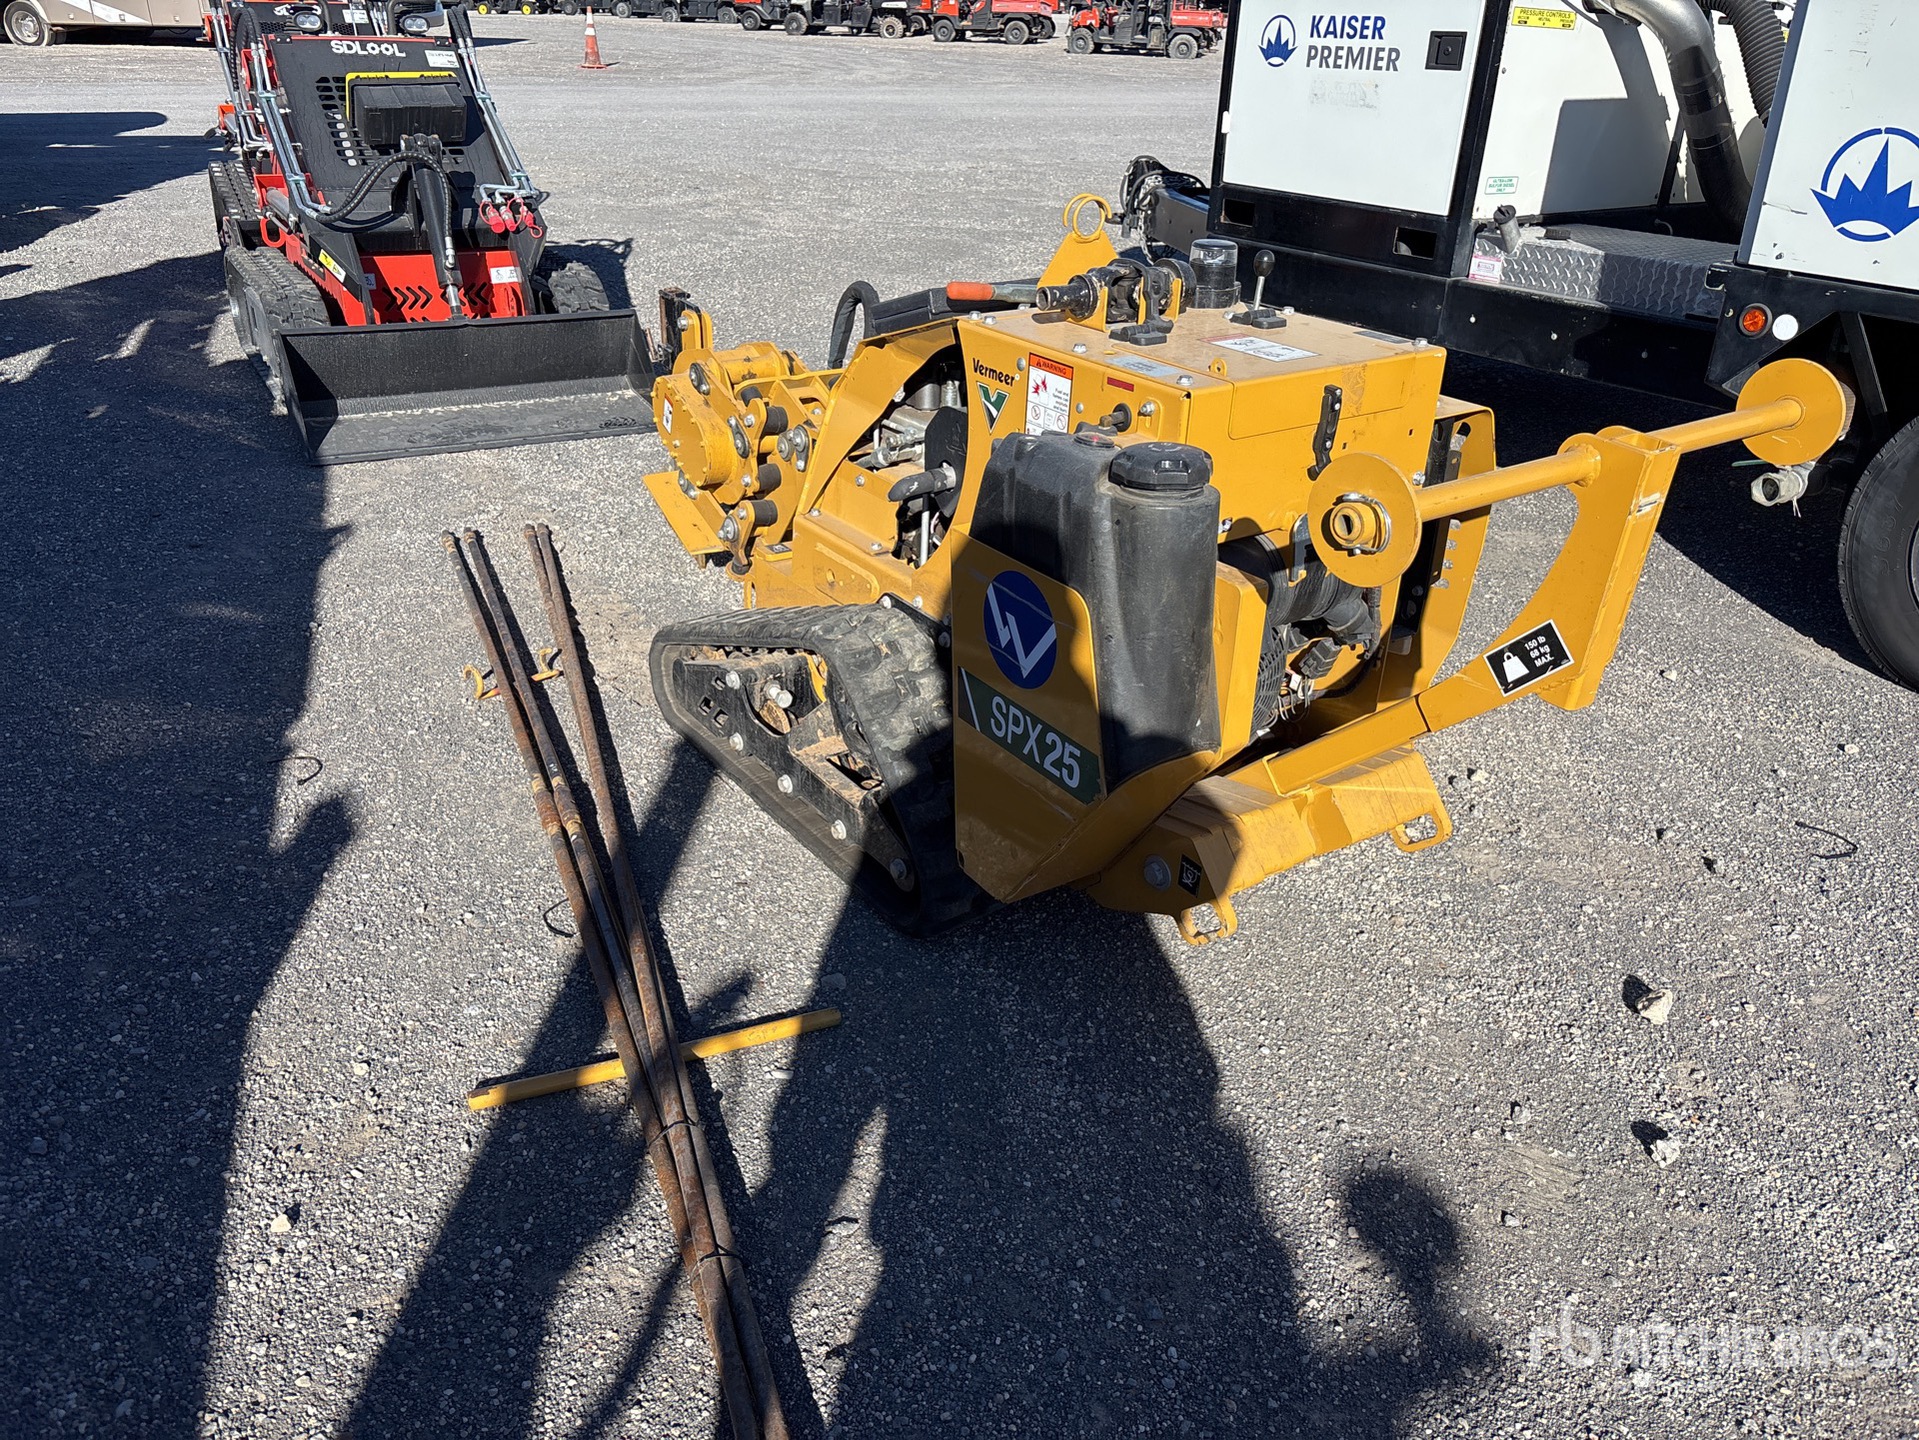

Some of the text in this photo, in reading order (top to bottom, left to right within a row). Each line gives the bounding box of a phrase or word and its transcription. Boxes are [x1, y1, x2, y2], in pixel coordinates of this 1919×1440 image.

[1546, 11, 1571, 19] CONTROLS
[1309, 15, 1386, 40] KAISER
[1306, 45, 1401, 72] PREMIER
[972, 357, 1015, 387] Vermeer
[1041, 360, 1067, 376] WARNING
[1525, 635, 1546, 650] 150 lb
[1529, 644, 1551, 659] 68 kg
[1533, 653, 1554, 667] MAX.
[990, 696, 1081, 788] SPX25
